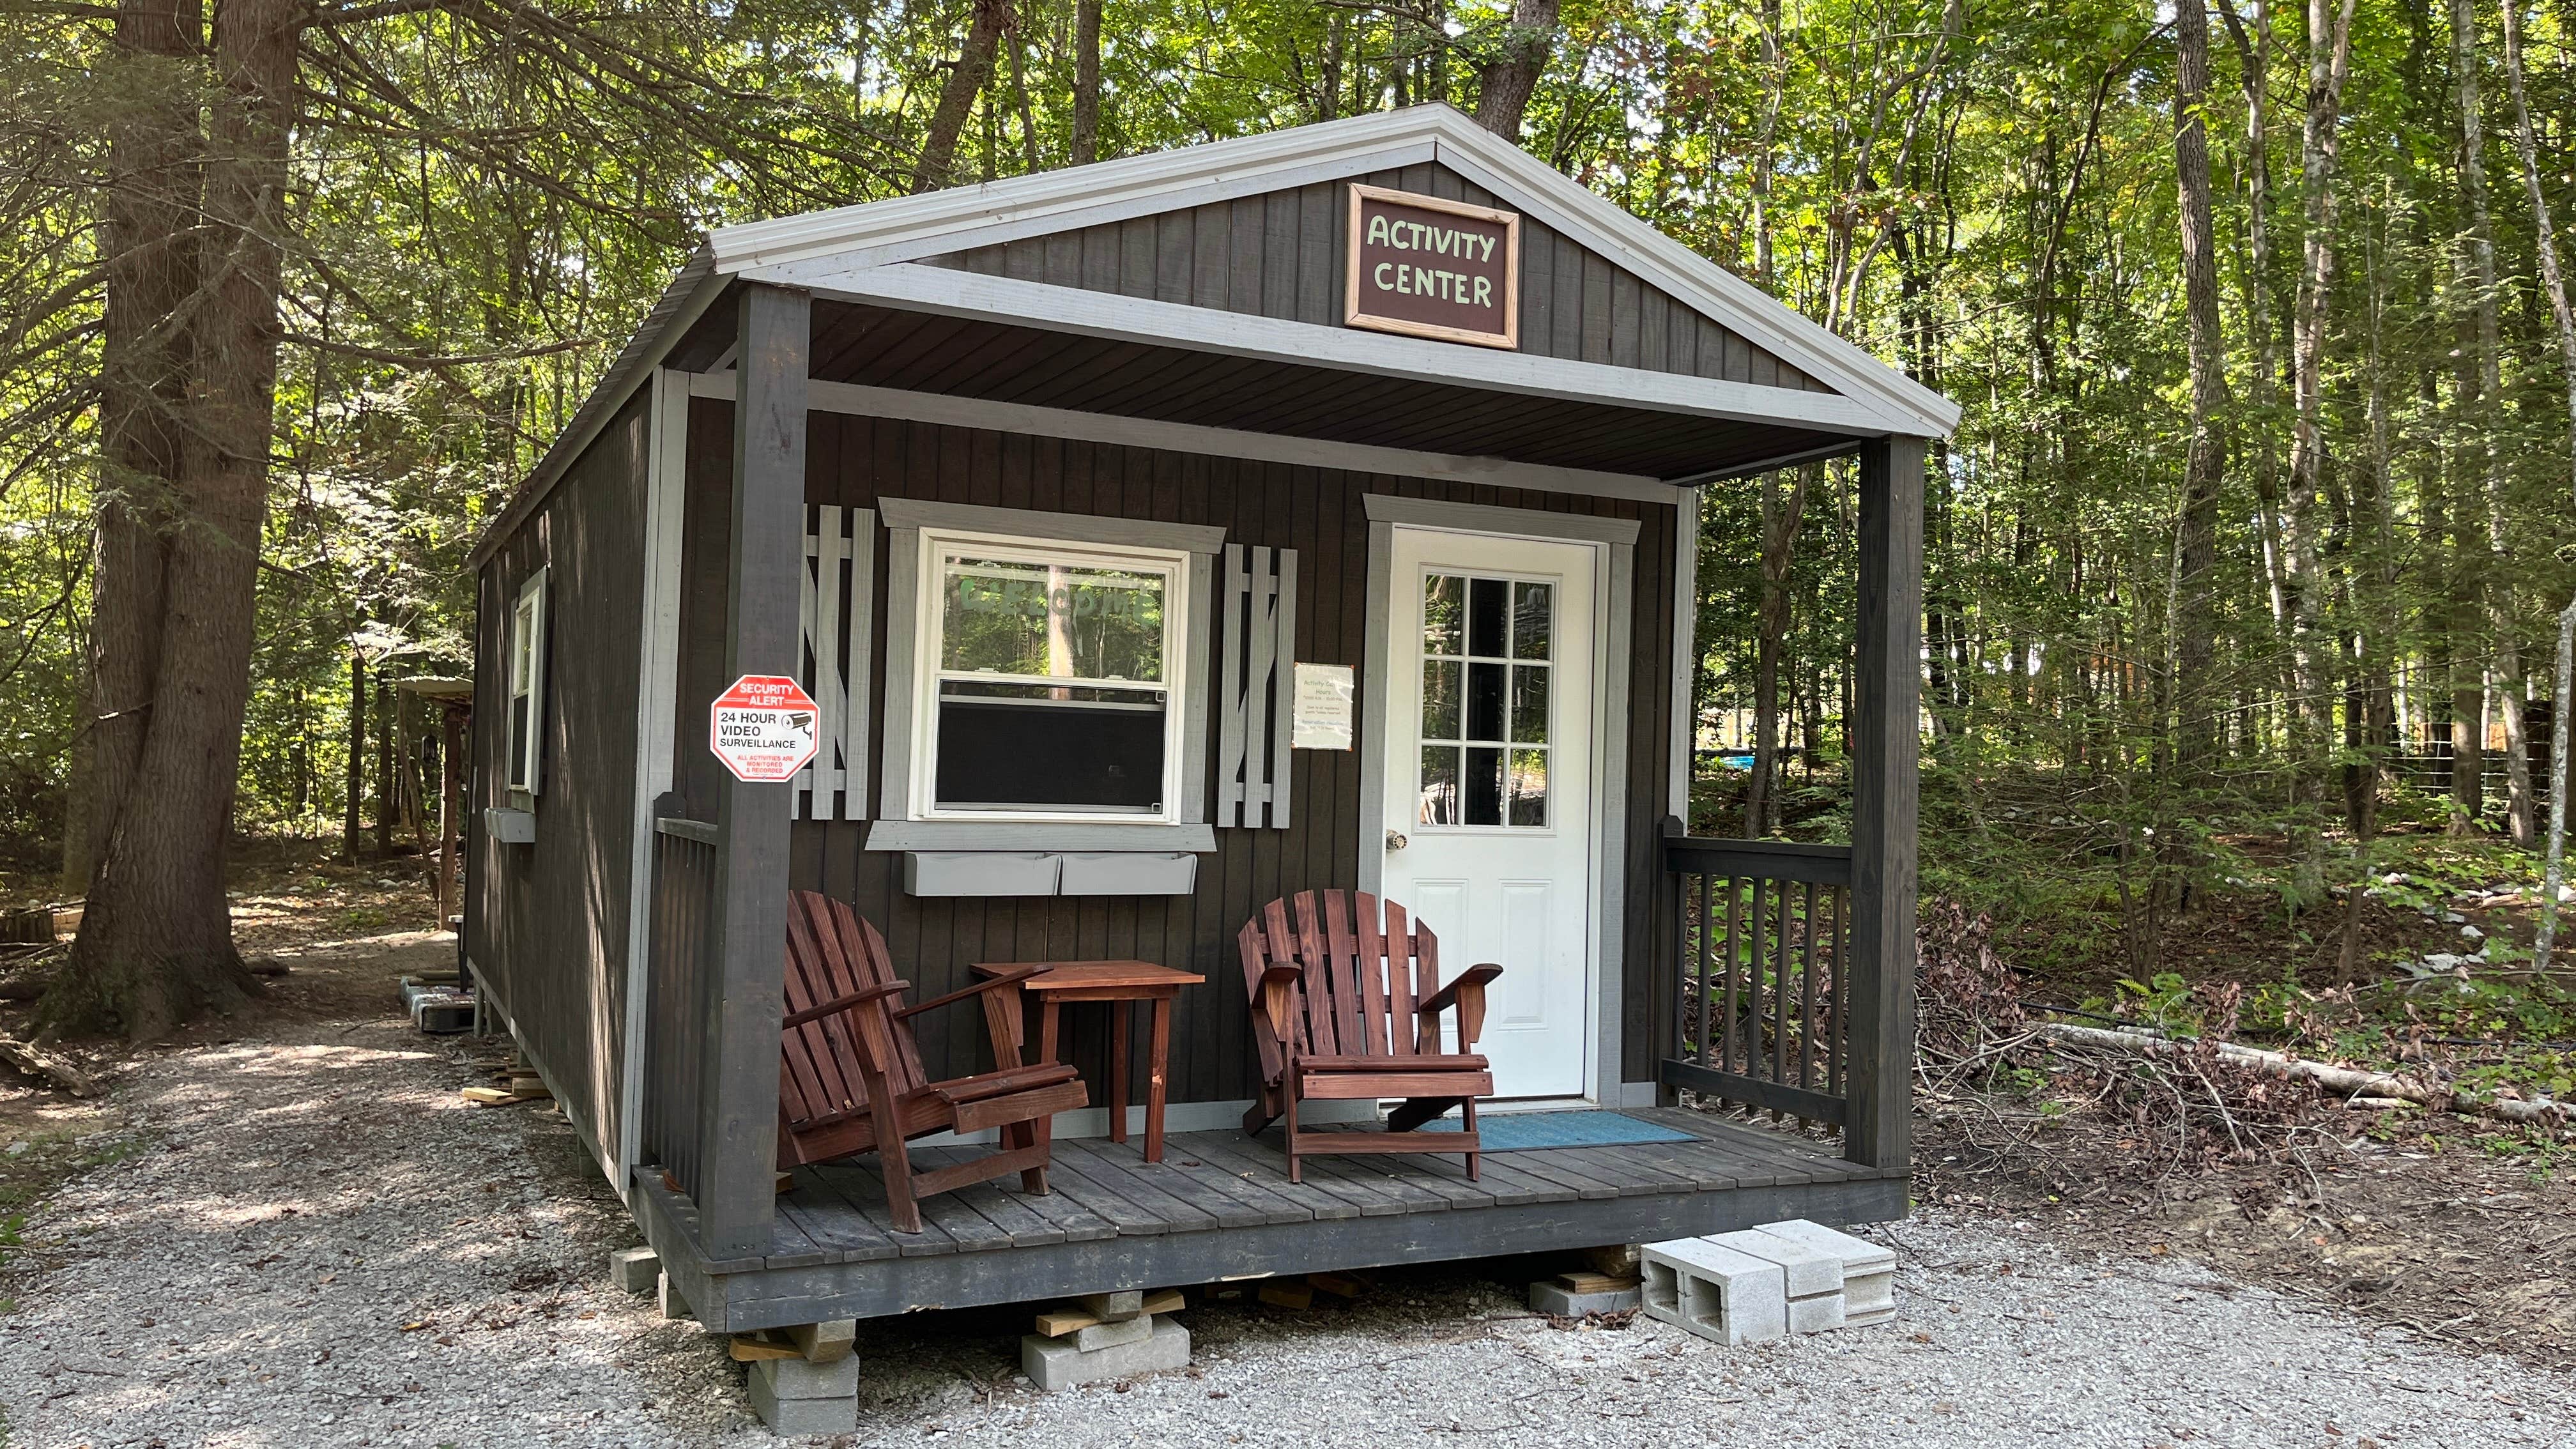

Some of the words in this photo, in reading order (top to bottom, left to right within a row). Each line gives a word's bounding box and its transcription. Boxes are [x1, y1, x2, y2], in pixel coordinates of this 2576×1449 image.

[1367, 215, 1496, 263] ACTIVITY
[1374, 263, 1492, 308] CENTER
[740, 683, 794, 694] SECURITY
[749, 696, 785, 706] ALERT
[721, 712, 736, 723] 24
[740, 713, 776, 724] HOUR
[721, 725, 761, 736] VIDEO
[720, 739, 796, 749] SURVEILLANCE
